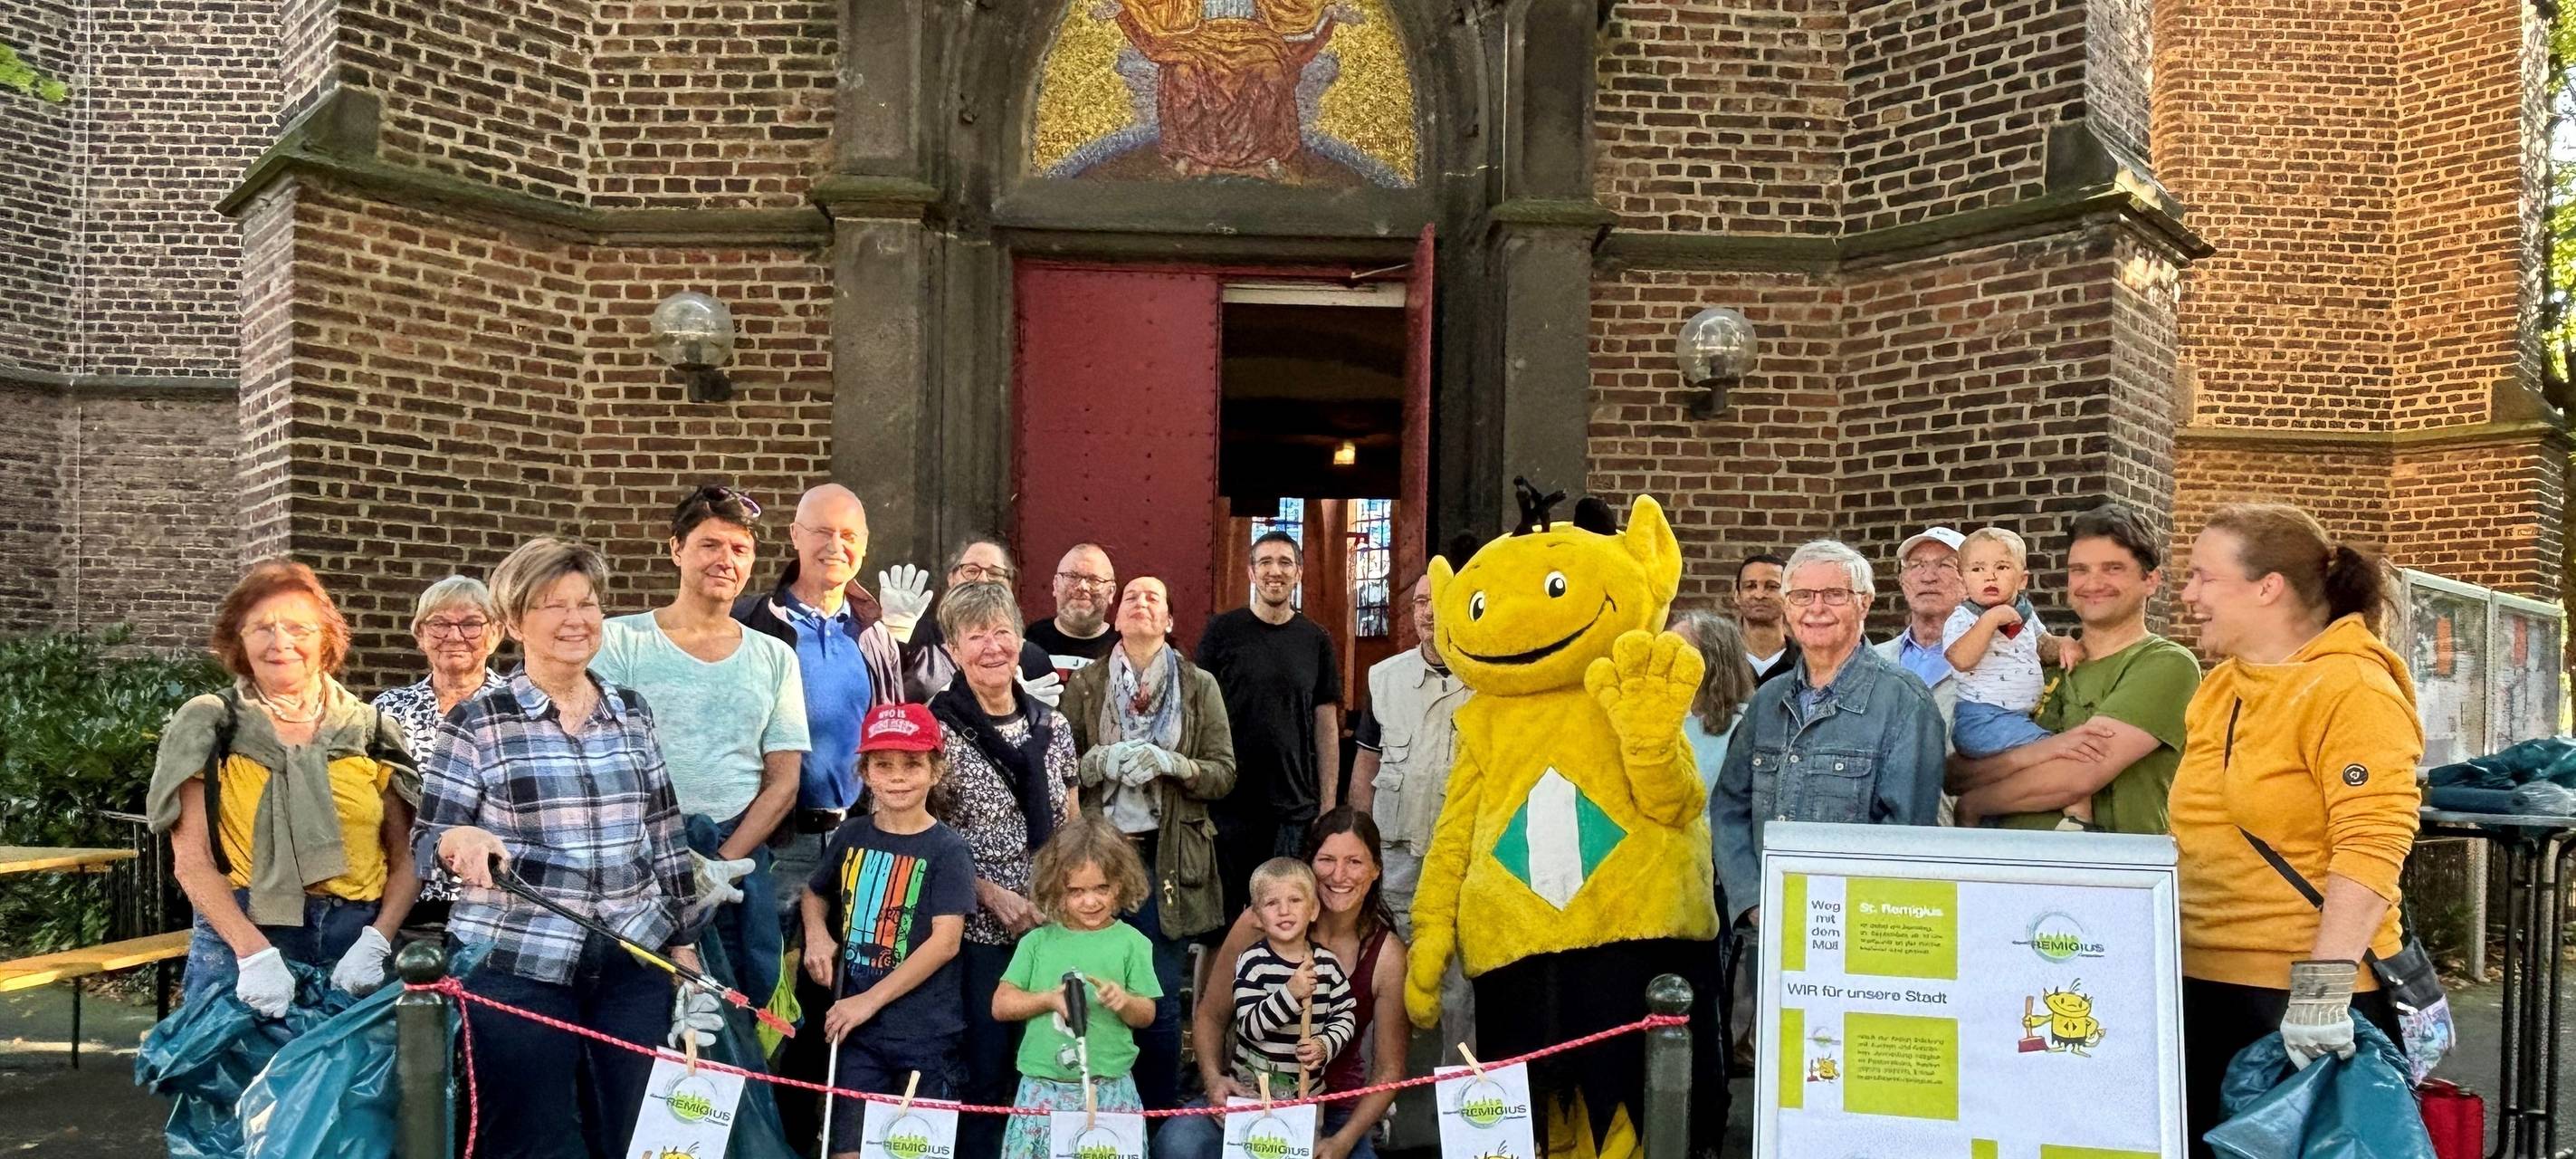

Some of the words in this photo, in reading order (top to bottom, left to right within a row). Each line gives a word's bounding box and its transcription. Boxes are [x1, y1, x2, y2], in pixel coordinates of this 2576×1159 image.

[1811, 899, 1841, 913] Weg
[1881, 903, 1944, 919] Remigius
[1816, 914, 1836, 924] mit
[1811, 926, 1840, 937] dem
[2031, 940, 2104, 953] REMIGIUS
[1787, 982, 1818, 996] WIR
[1821, 984, 1843, 998] für
[1846, 990, 1901, 1001] unsere
[1904, 990, 1948, 1004] Stadt
[666, 1097, 731, 1122] REMIGIUS
[1460, 1104, 1527, 1118] REMIGIUS
[883, 1140, 950, 1155] REMIGIUS
[1243, 1142, 1310, 1157] REMIGIUS
